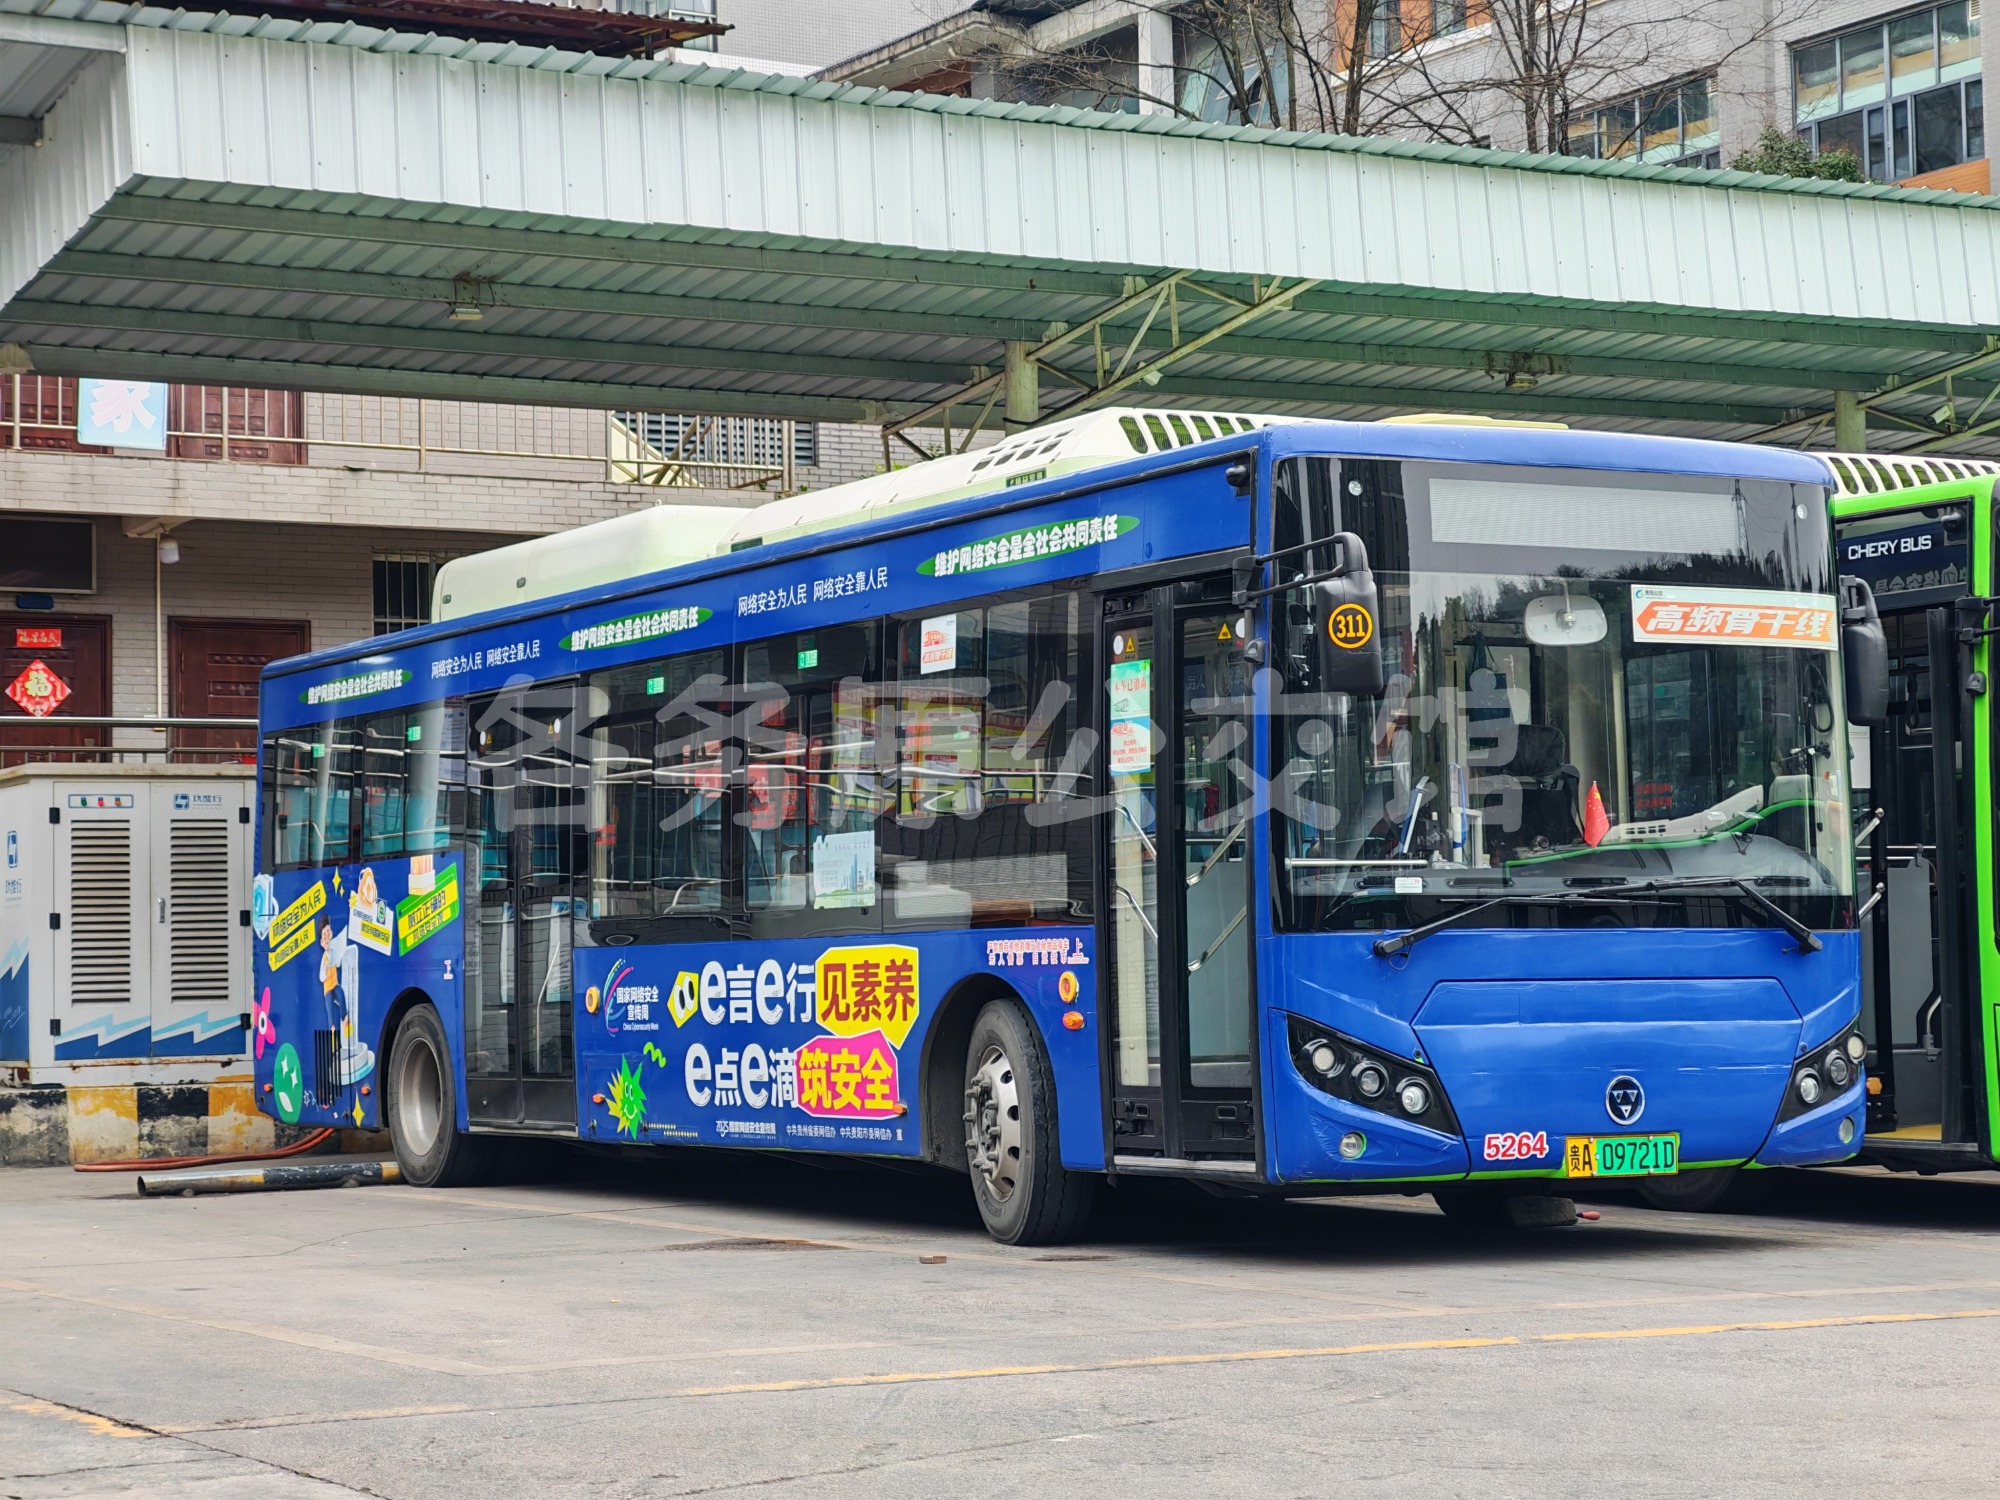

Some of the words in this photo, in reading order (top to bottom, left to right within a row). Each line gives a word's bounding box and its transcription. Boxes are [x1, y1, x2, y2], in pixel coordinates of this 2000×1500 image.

[934, 514, 1118, 578] 维护网络安全是全社会共同责任
[1848, 539, 1899, 560] CHERY
[1901, 535, 1932, 553] BUS
[738, 583, 807, 618] 网络安全为人民
[813, 566, 888, 601] 网络安全靠人民
[571, 606, 699, 652] 维护网络安全是全社会共同责任
[1336, 614, 1366, 639] 311
[1646, 604, 1828, 638] 高频骨干线
[431, 651, 482, 679] 网络安全为人民
[486, 639, 540, 667] 网络安全靠人民
[25, 670, 52, 697] 福
[307, 670, 403, 704] 维护网络安全是全社会共同责任
[1114, 676, 1147, 693] 本车已消毒
[616, 985, 659, 1003] 国家网络安全
[627, 1004, 649, 1020] 宣传周
[786, 1124, 836, 1138] 中共贵州省委网信办
[840, 1126, 892, 1140] 中共贵阳市委网信办
[1485, 1133, 1547, 1159] 5264
